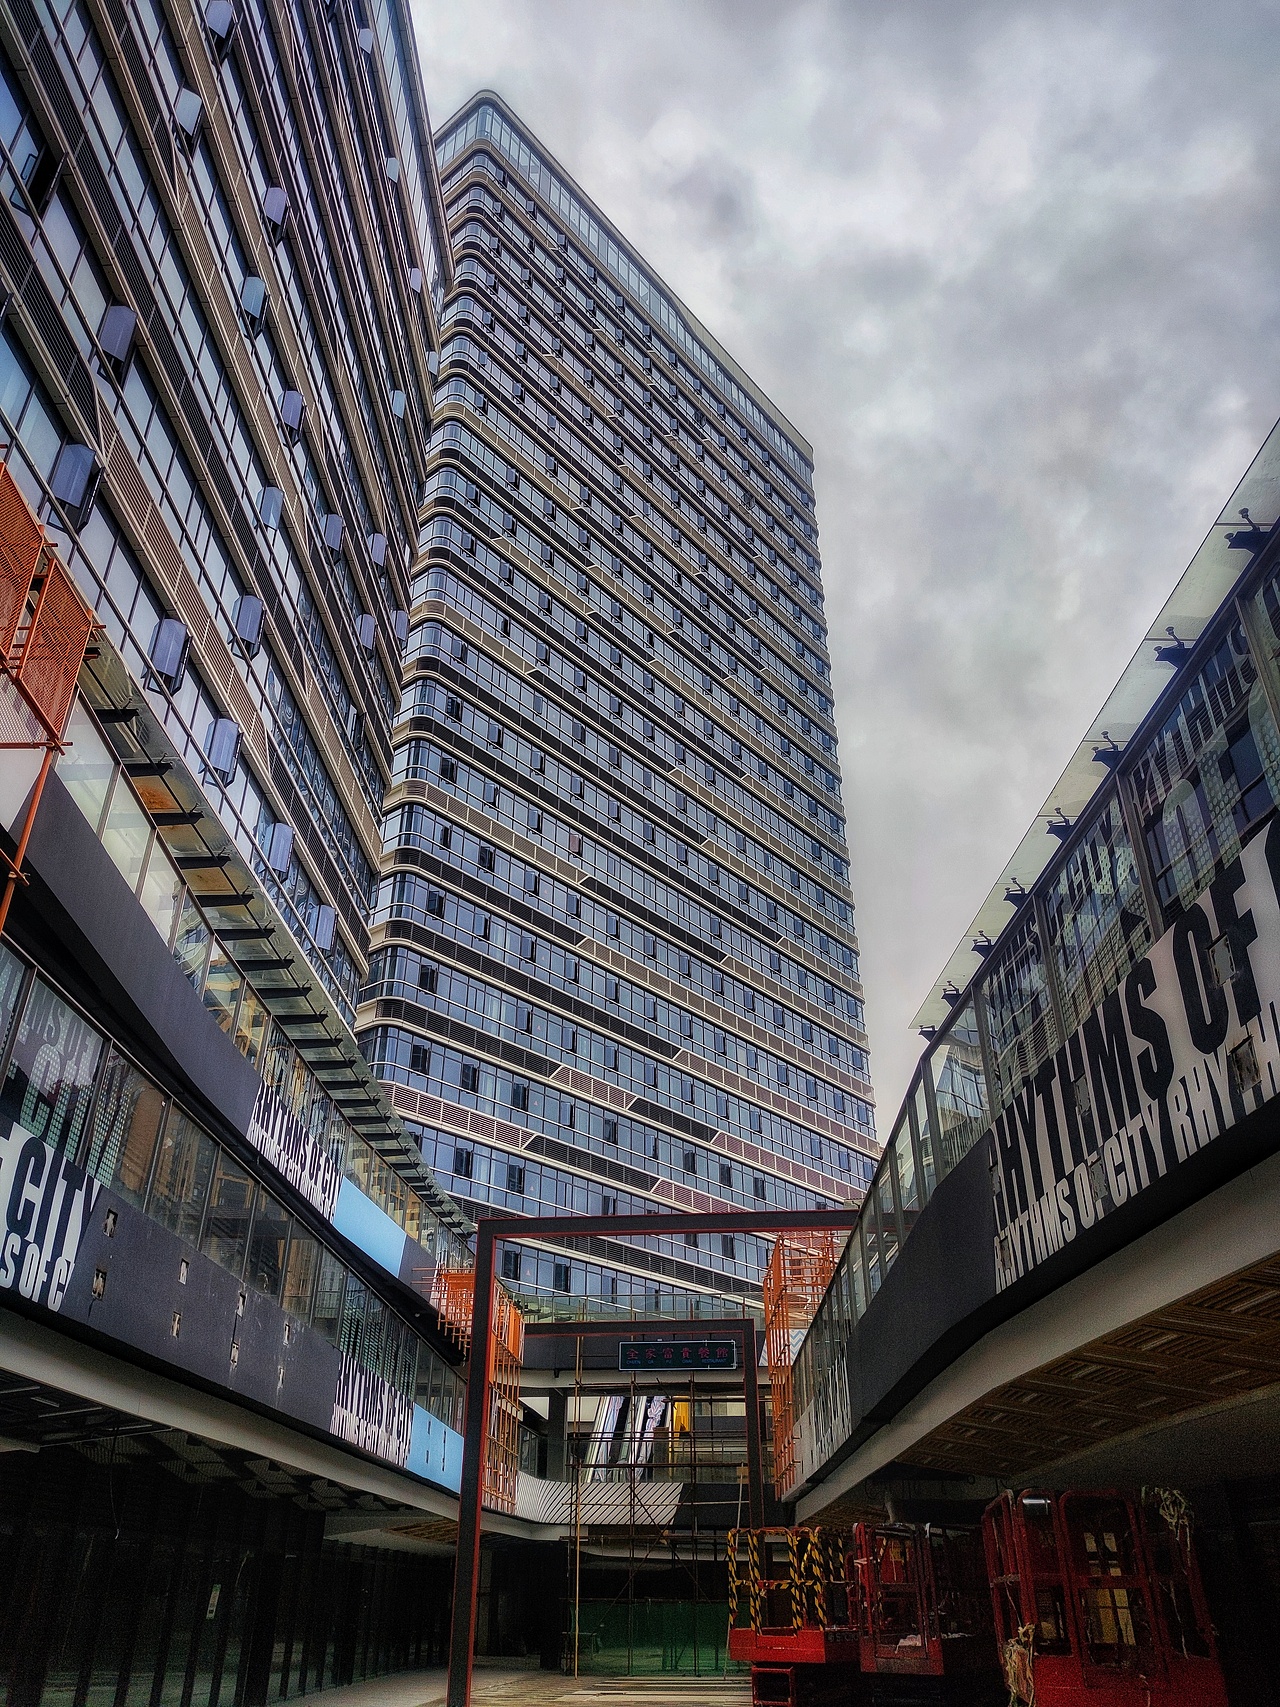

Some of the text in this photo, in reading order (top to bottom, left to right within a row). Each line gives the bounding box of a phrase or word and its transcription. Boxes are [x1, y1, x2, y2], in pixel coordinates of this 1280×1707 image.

[1162, 722, 1241, 912] OF
[1173, 854, 1262, 1055] OF
[1104, 1101, 1168, 1207] CITY
[19, 1243, 51, 1304] OF
